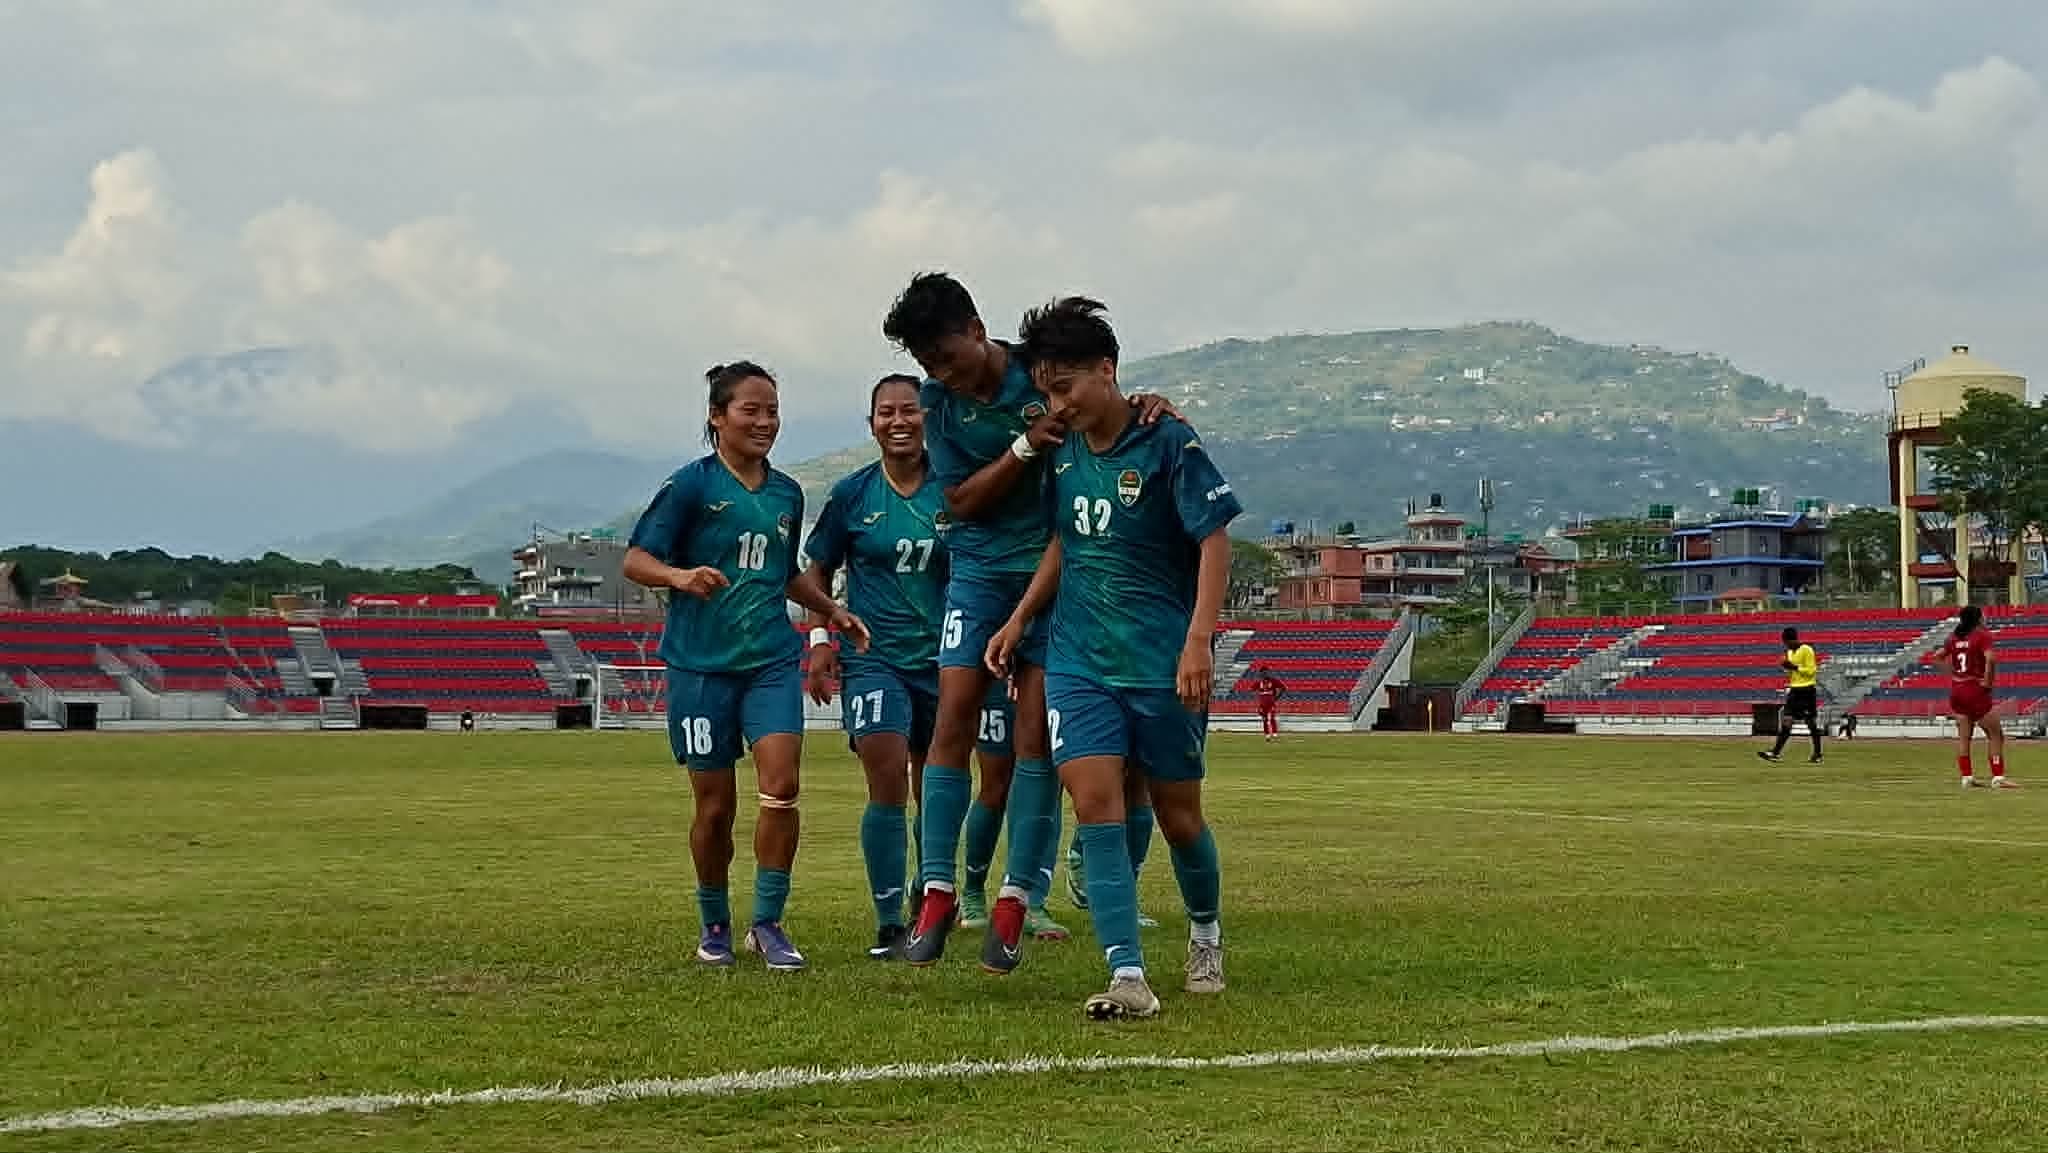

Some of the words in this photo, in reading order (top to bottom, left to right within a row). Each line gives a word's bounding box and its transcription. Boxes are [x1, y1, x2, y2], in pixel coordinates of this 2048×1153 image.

[1073, 495, 1112, 537] 32
[738, 531, 768, 571] 18
[895, 538, 935, 573] 27
[851, 689, 884, 729] 27
[681, 716, 713, 755] 18
[1047, 707, 1064, 752] 2
